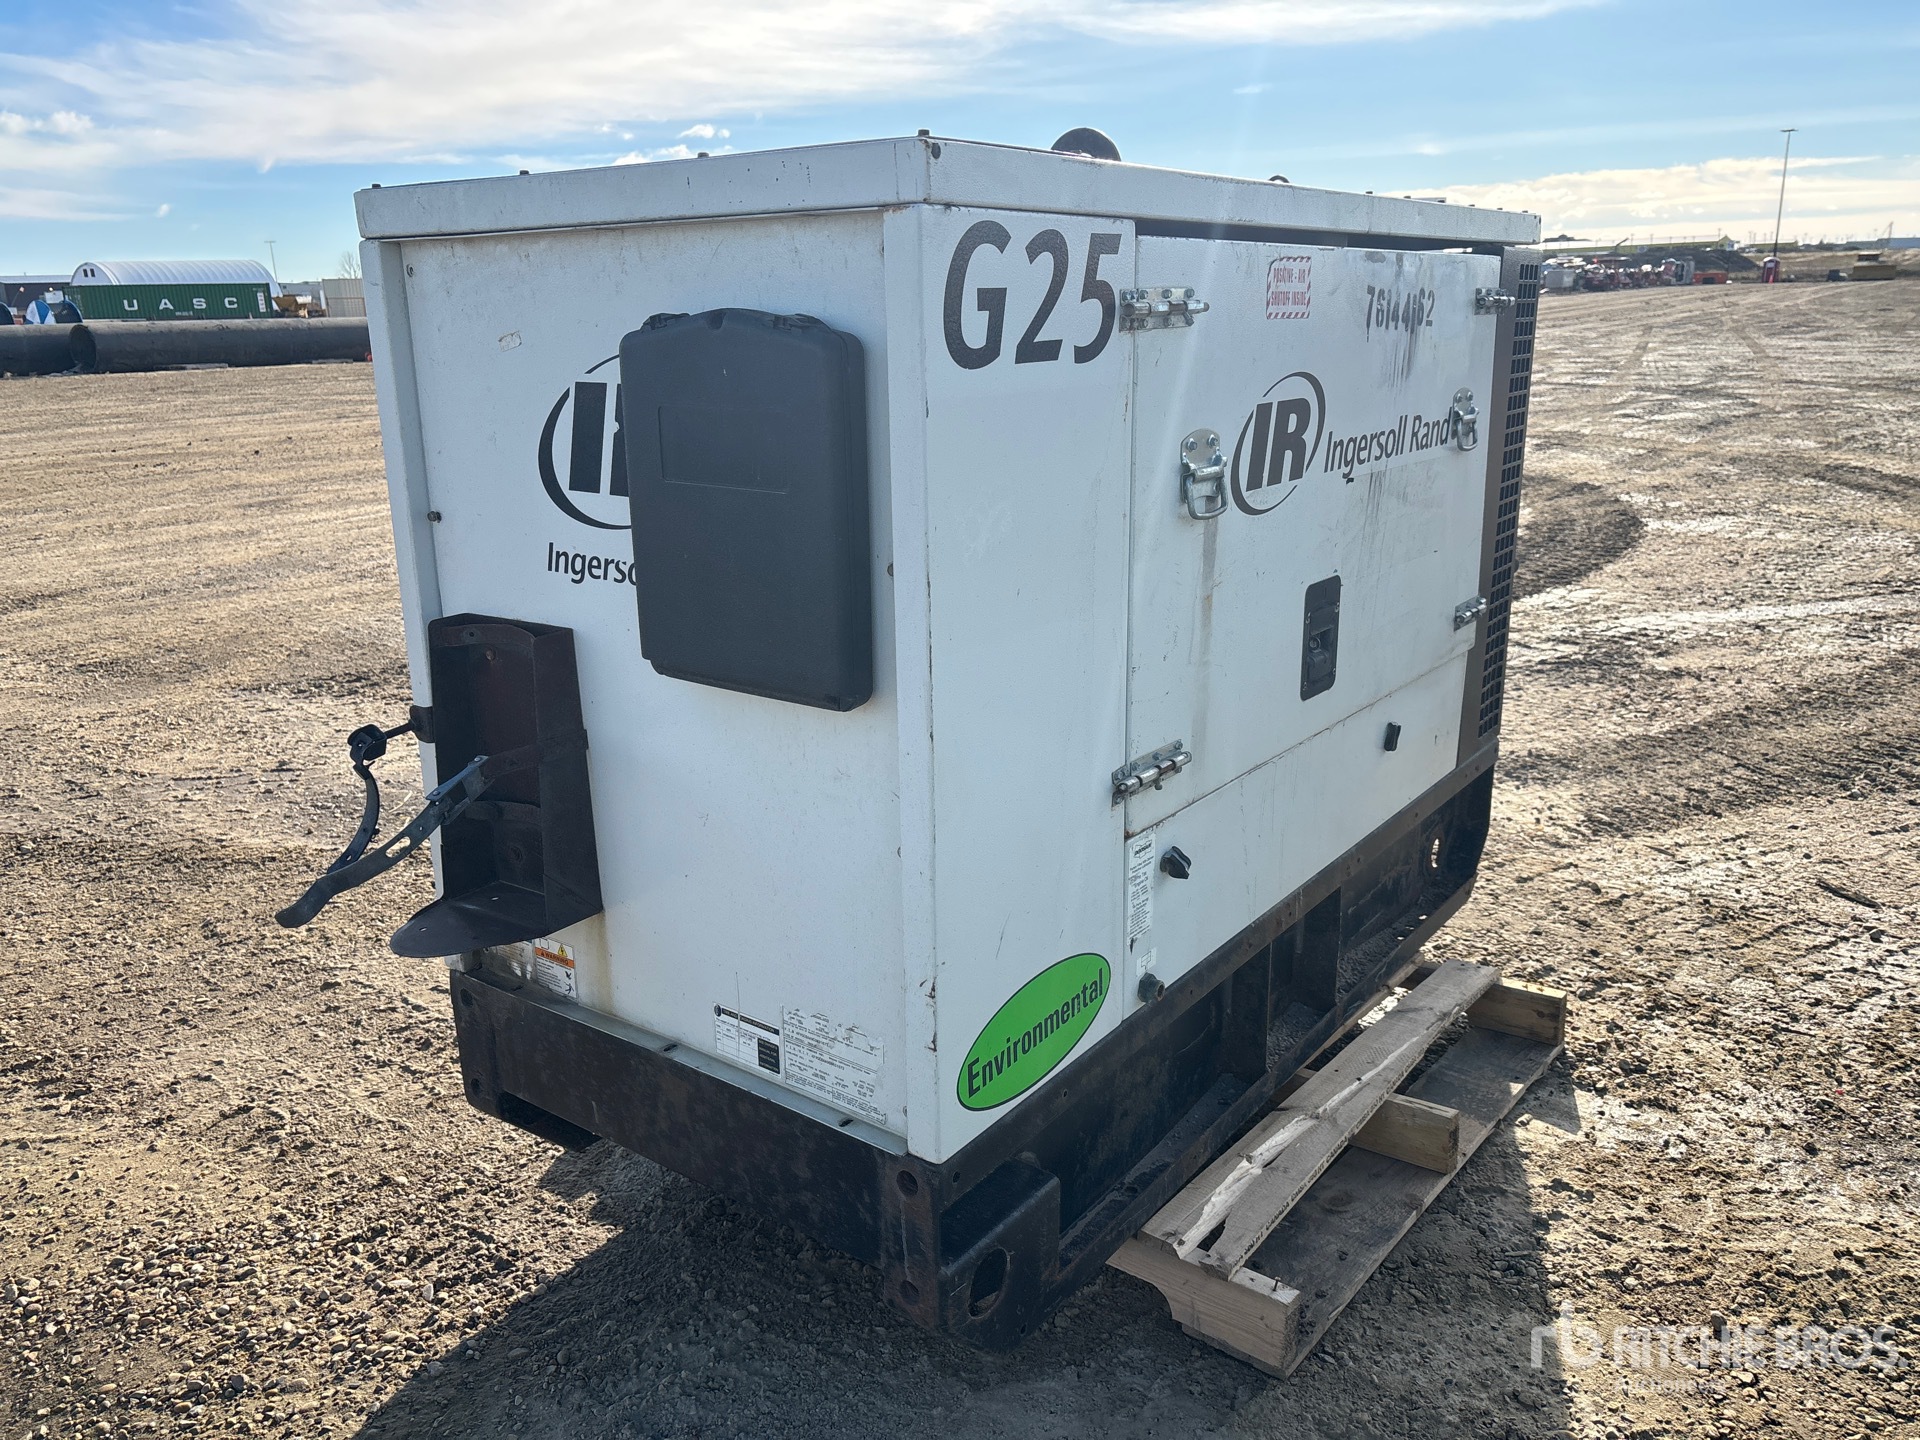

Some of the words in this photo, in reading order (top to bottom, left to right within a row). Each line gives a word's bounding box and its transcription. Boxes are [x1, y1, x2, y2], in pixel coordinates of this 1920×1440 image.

[123, 297, 238, 311] UASC
[943, 220, 1122, 369] G25
[1271, 291, 1290, 306] SHUTOFF
[1291, 291, 1307, 306] INSIDE
[1274, 268, 1293, 283] POSITIVE
[1245, 397, 1311, 492] IR
[1323, 414, 1408, 480] Ingersoll
[1409, 406, 1453, 453] Rand
[967, 967, 1103, 1098] Environmental
